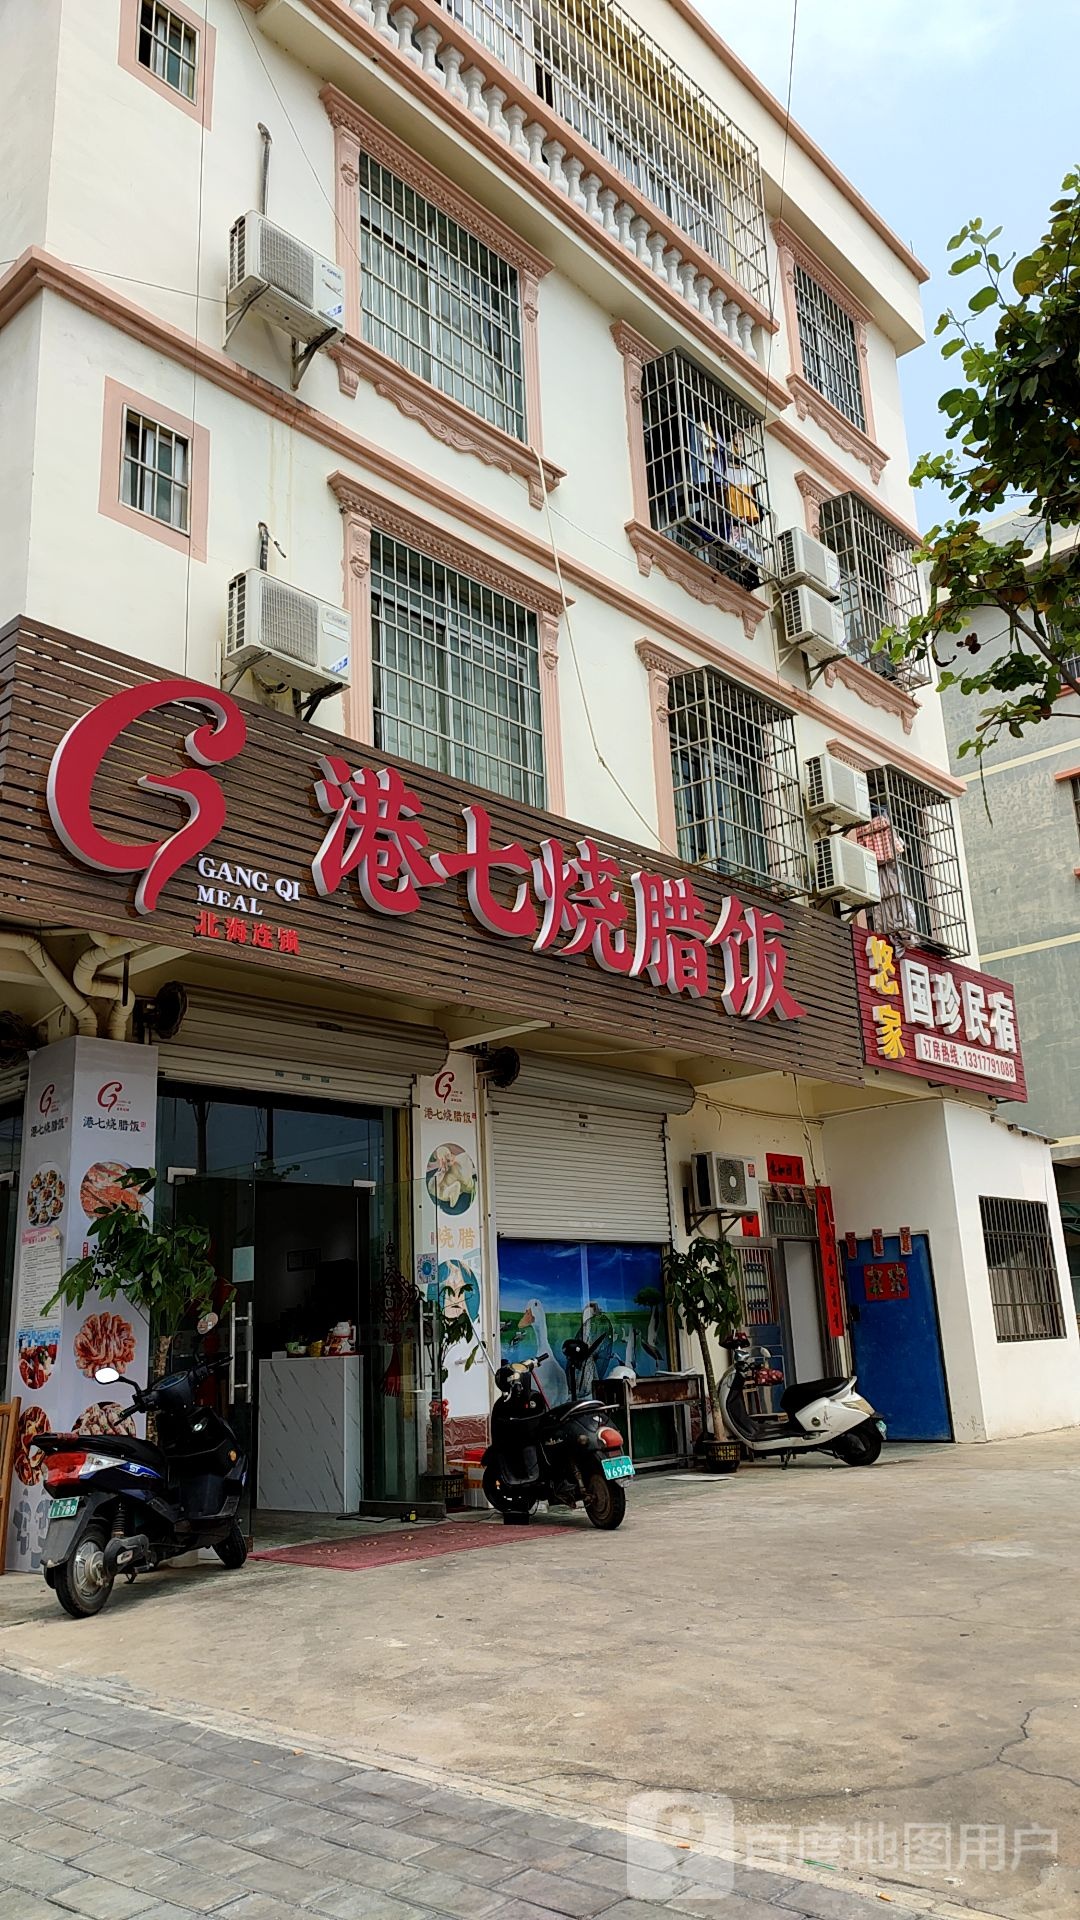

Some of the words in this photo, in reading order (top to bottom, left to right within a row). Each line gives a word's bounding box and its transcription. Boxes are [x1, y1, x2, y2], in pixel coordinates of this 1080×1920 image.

[198, 857, 269, 892] GANG
[275, 878, 300, 902] QI
[311, 754, 807, 1021] 港七烧腊饭
[197, 885, 263, 915] MEAL
[194, 910, 300, 955] 北海连锁
[900, 959, 1018, 1053] 国珍民宿
[30, 1117, 65, 1138] 港七烧腊饭
[82, 1115, 141, 1133] 港七烧腊饭
[424, 1106, 472, 1124] 港七烧腊饭
